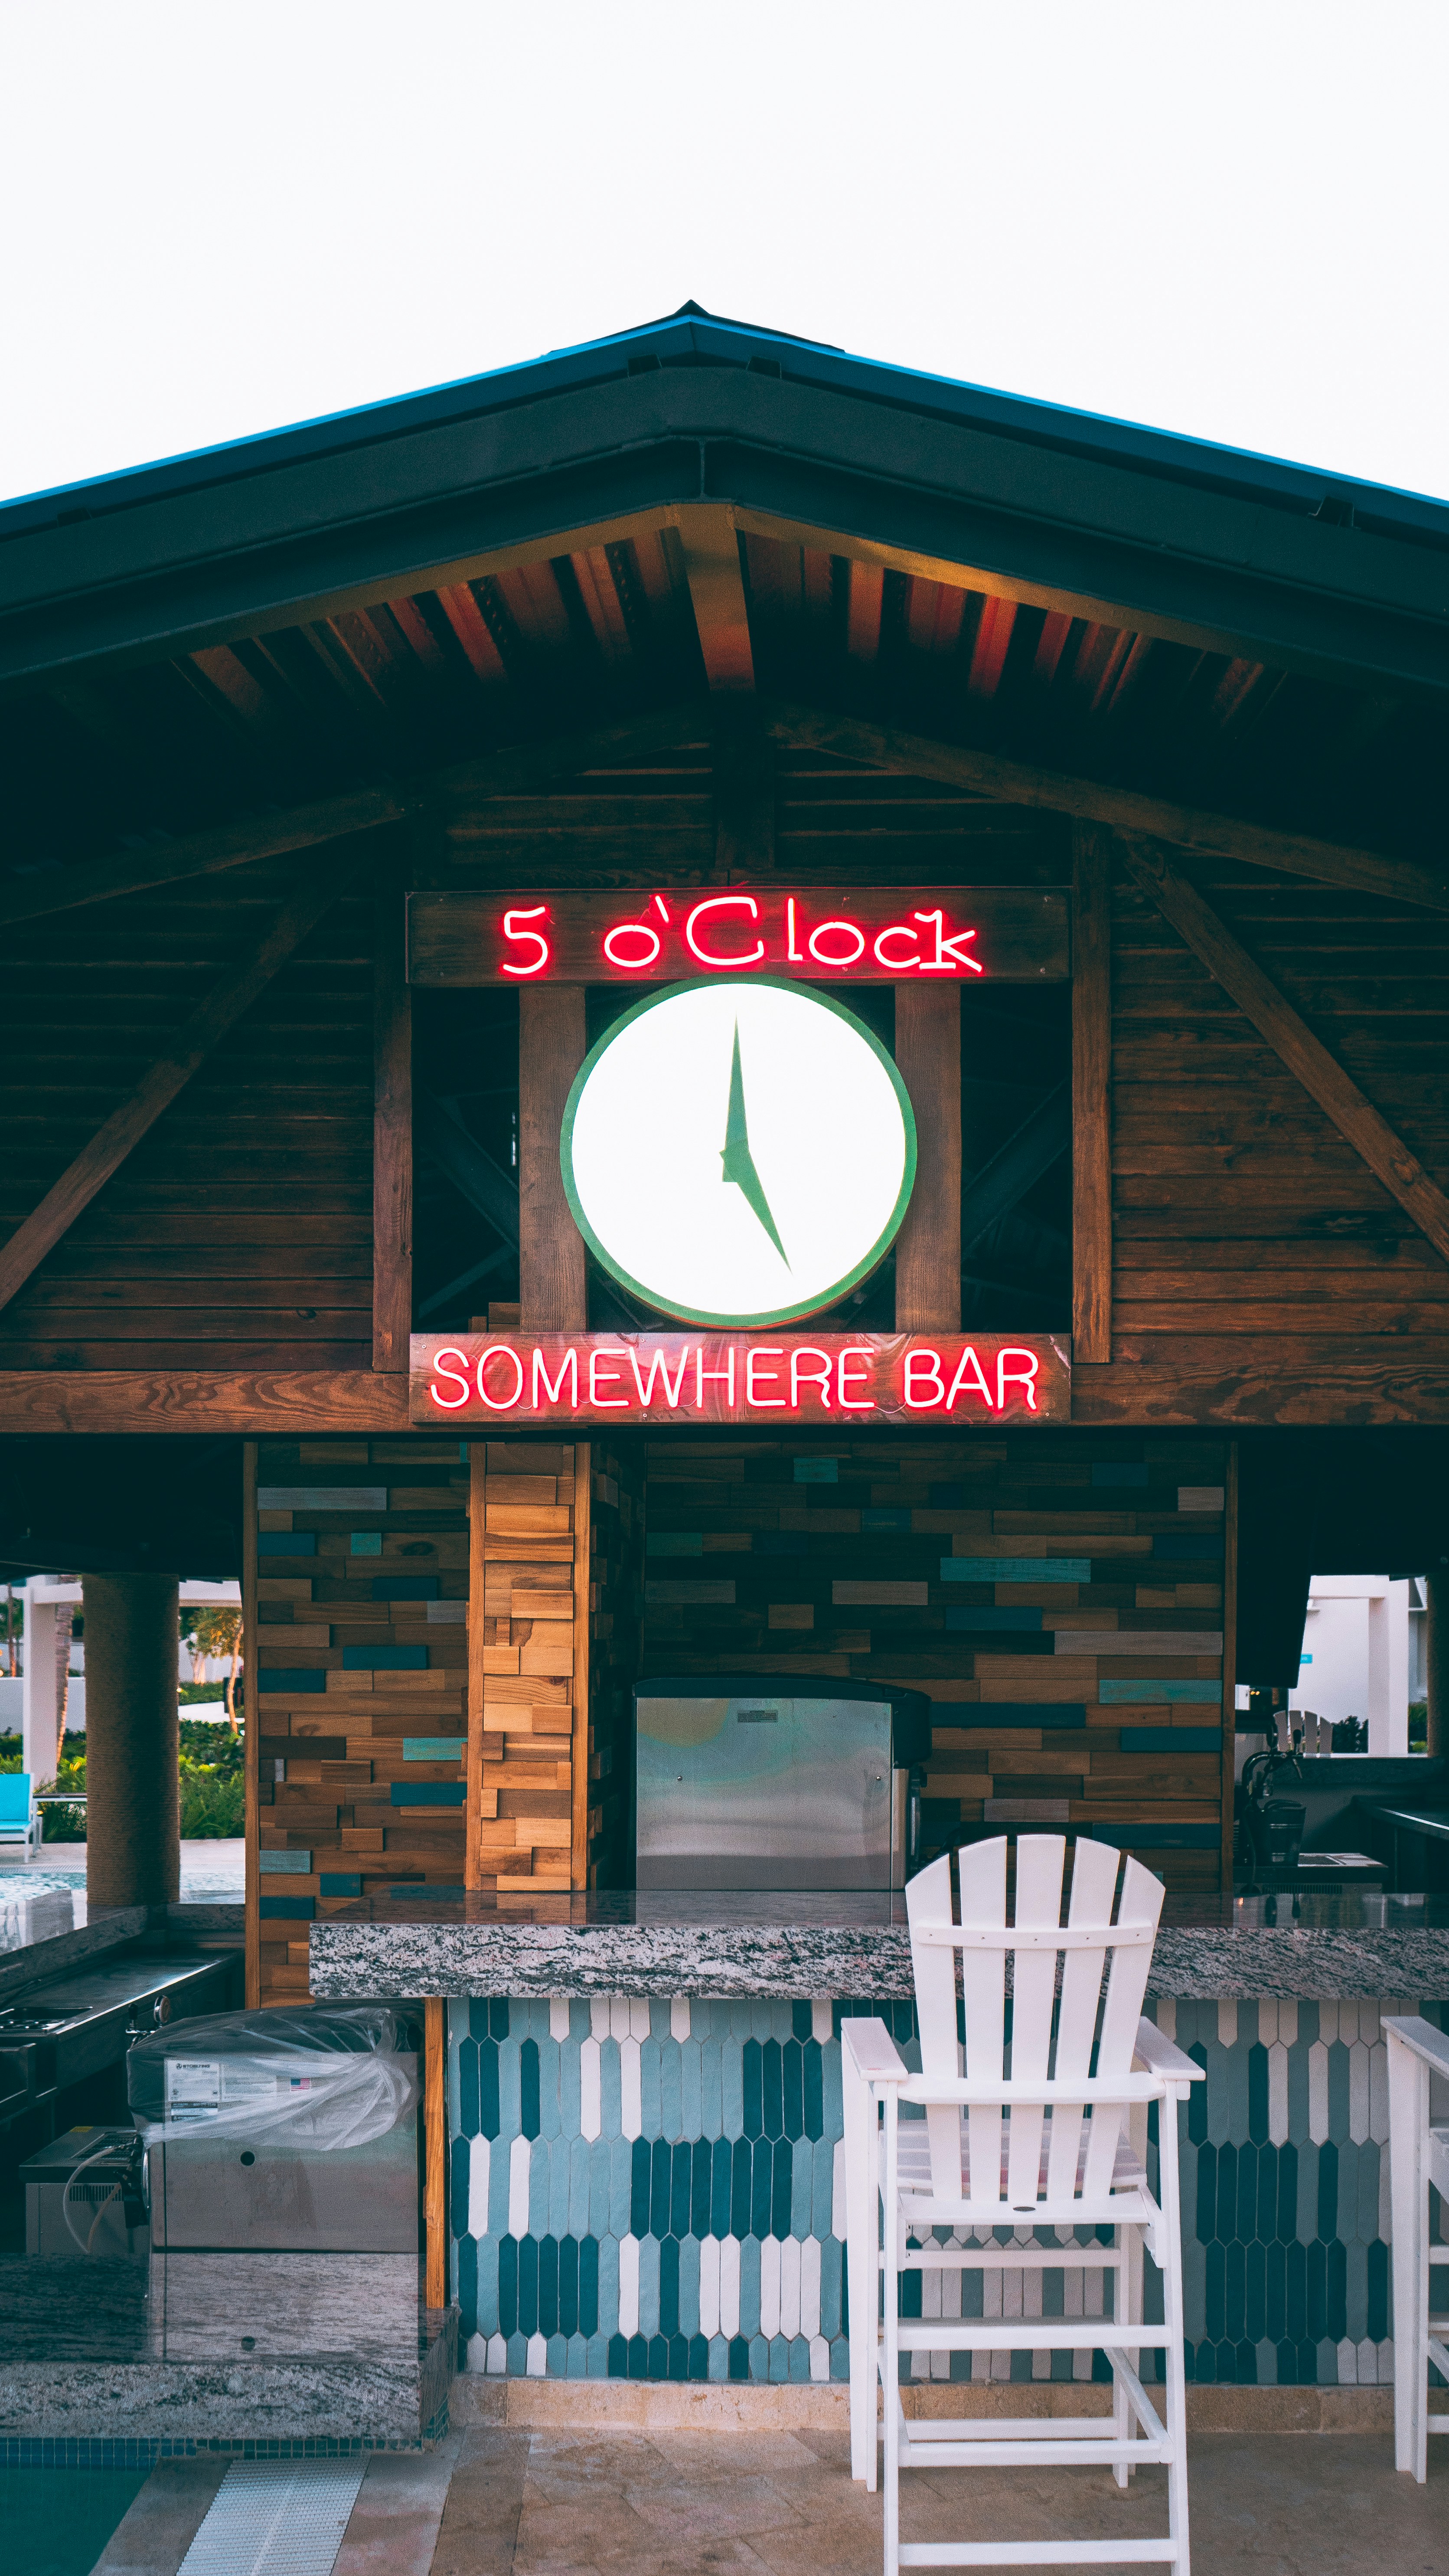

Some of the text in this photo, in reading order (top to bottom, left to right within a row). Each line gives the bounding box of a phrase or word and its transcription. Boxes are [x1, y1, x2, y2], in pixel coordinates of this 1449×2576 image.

[502, 906, 549, 975] 5
[431, 1345, 1039, 1410] SOMEWHERE BAR
